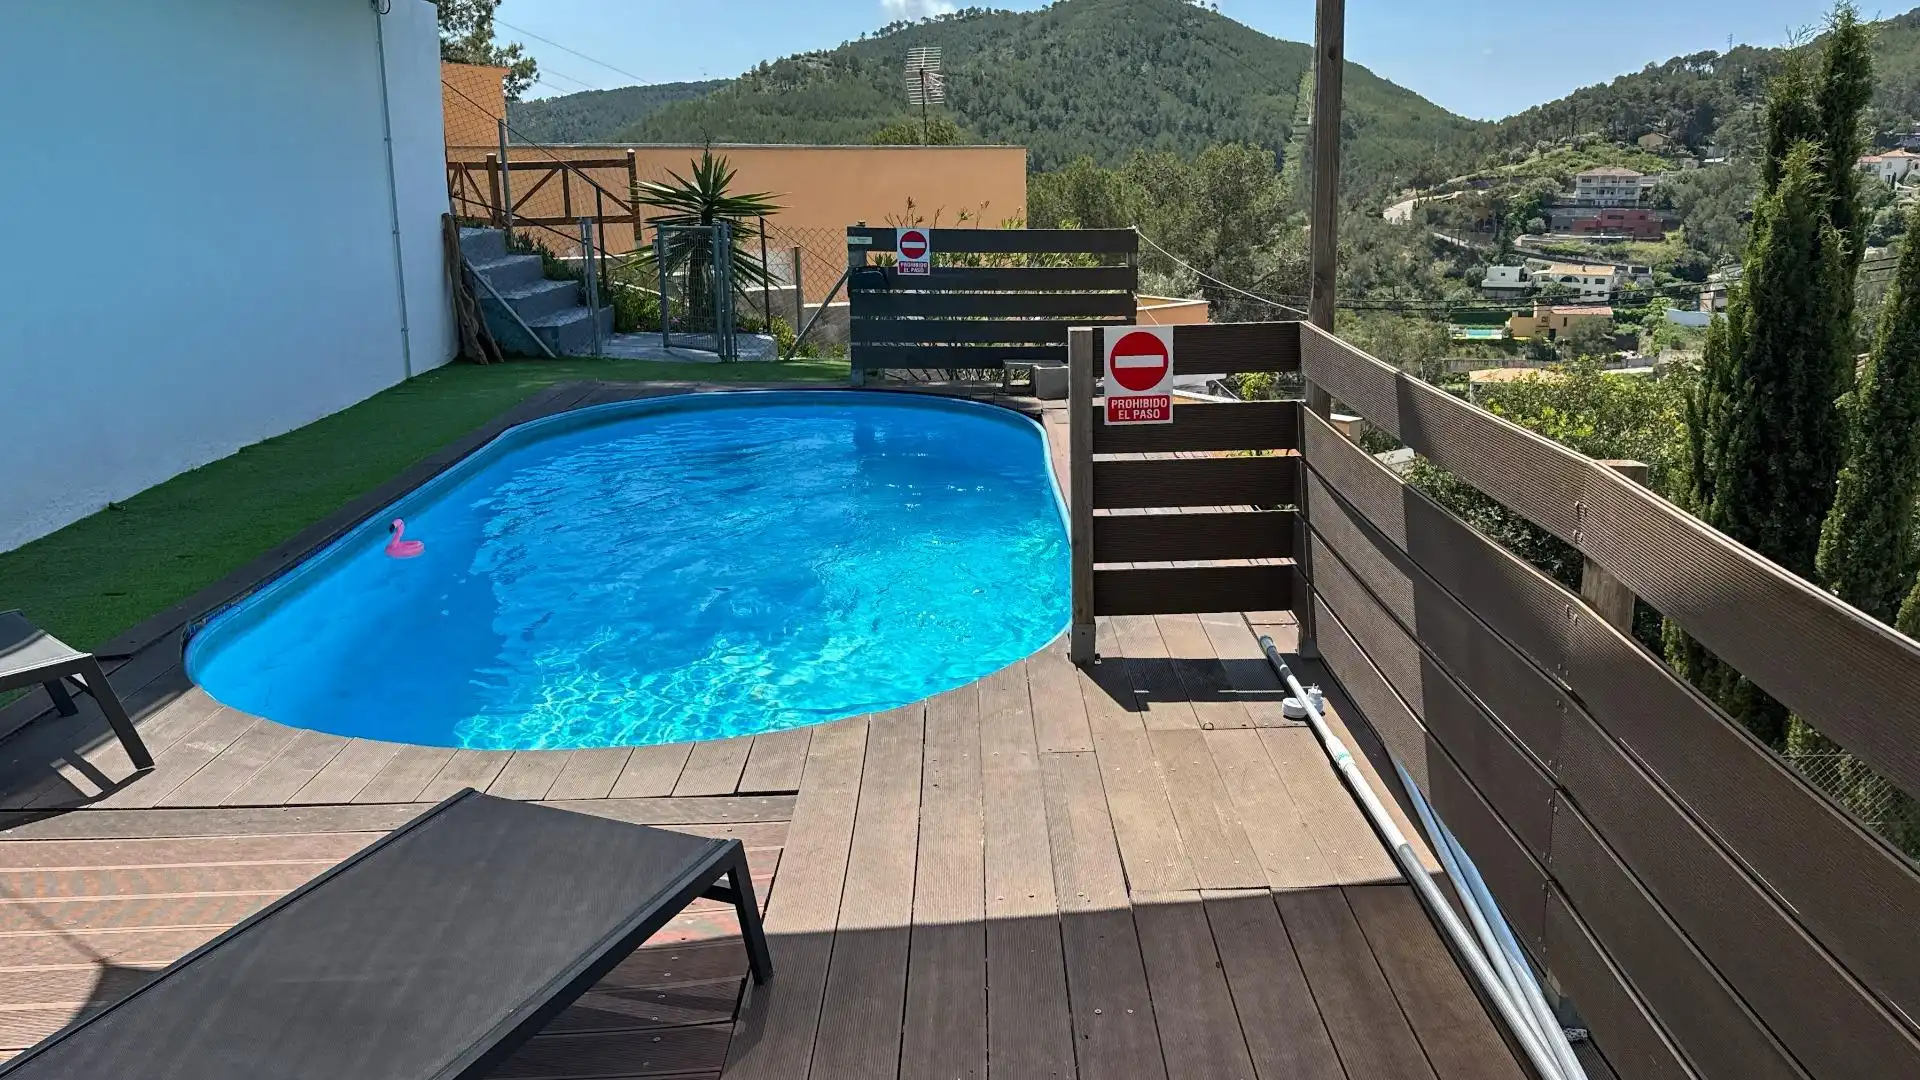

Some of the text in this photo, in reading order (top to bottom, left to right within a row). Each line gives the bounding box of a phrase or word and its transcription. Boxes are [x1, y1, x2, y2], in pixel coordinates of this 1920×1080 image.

[1111, 398, 1167, 409] PROHIBIDO
[1118, 409, 1160, 420] EL PASO
